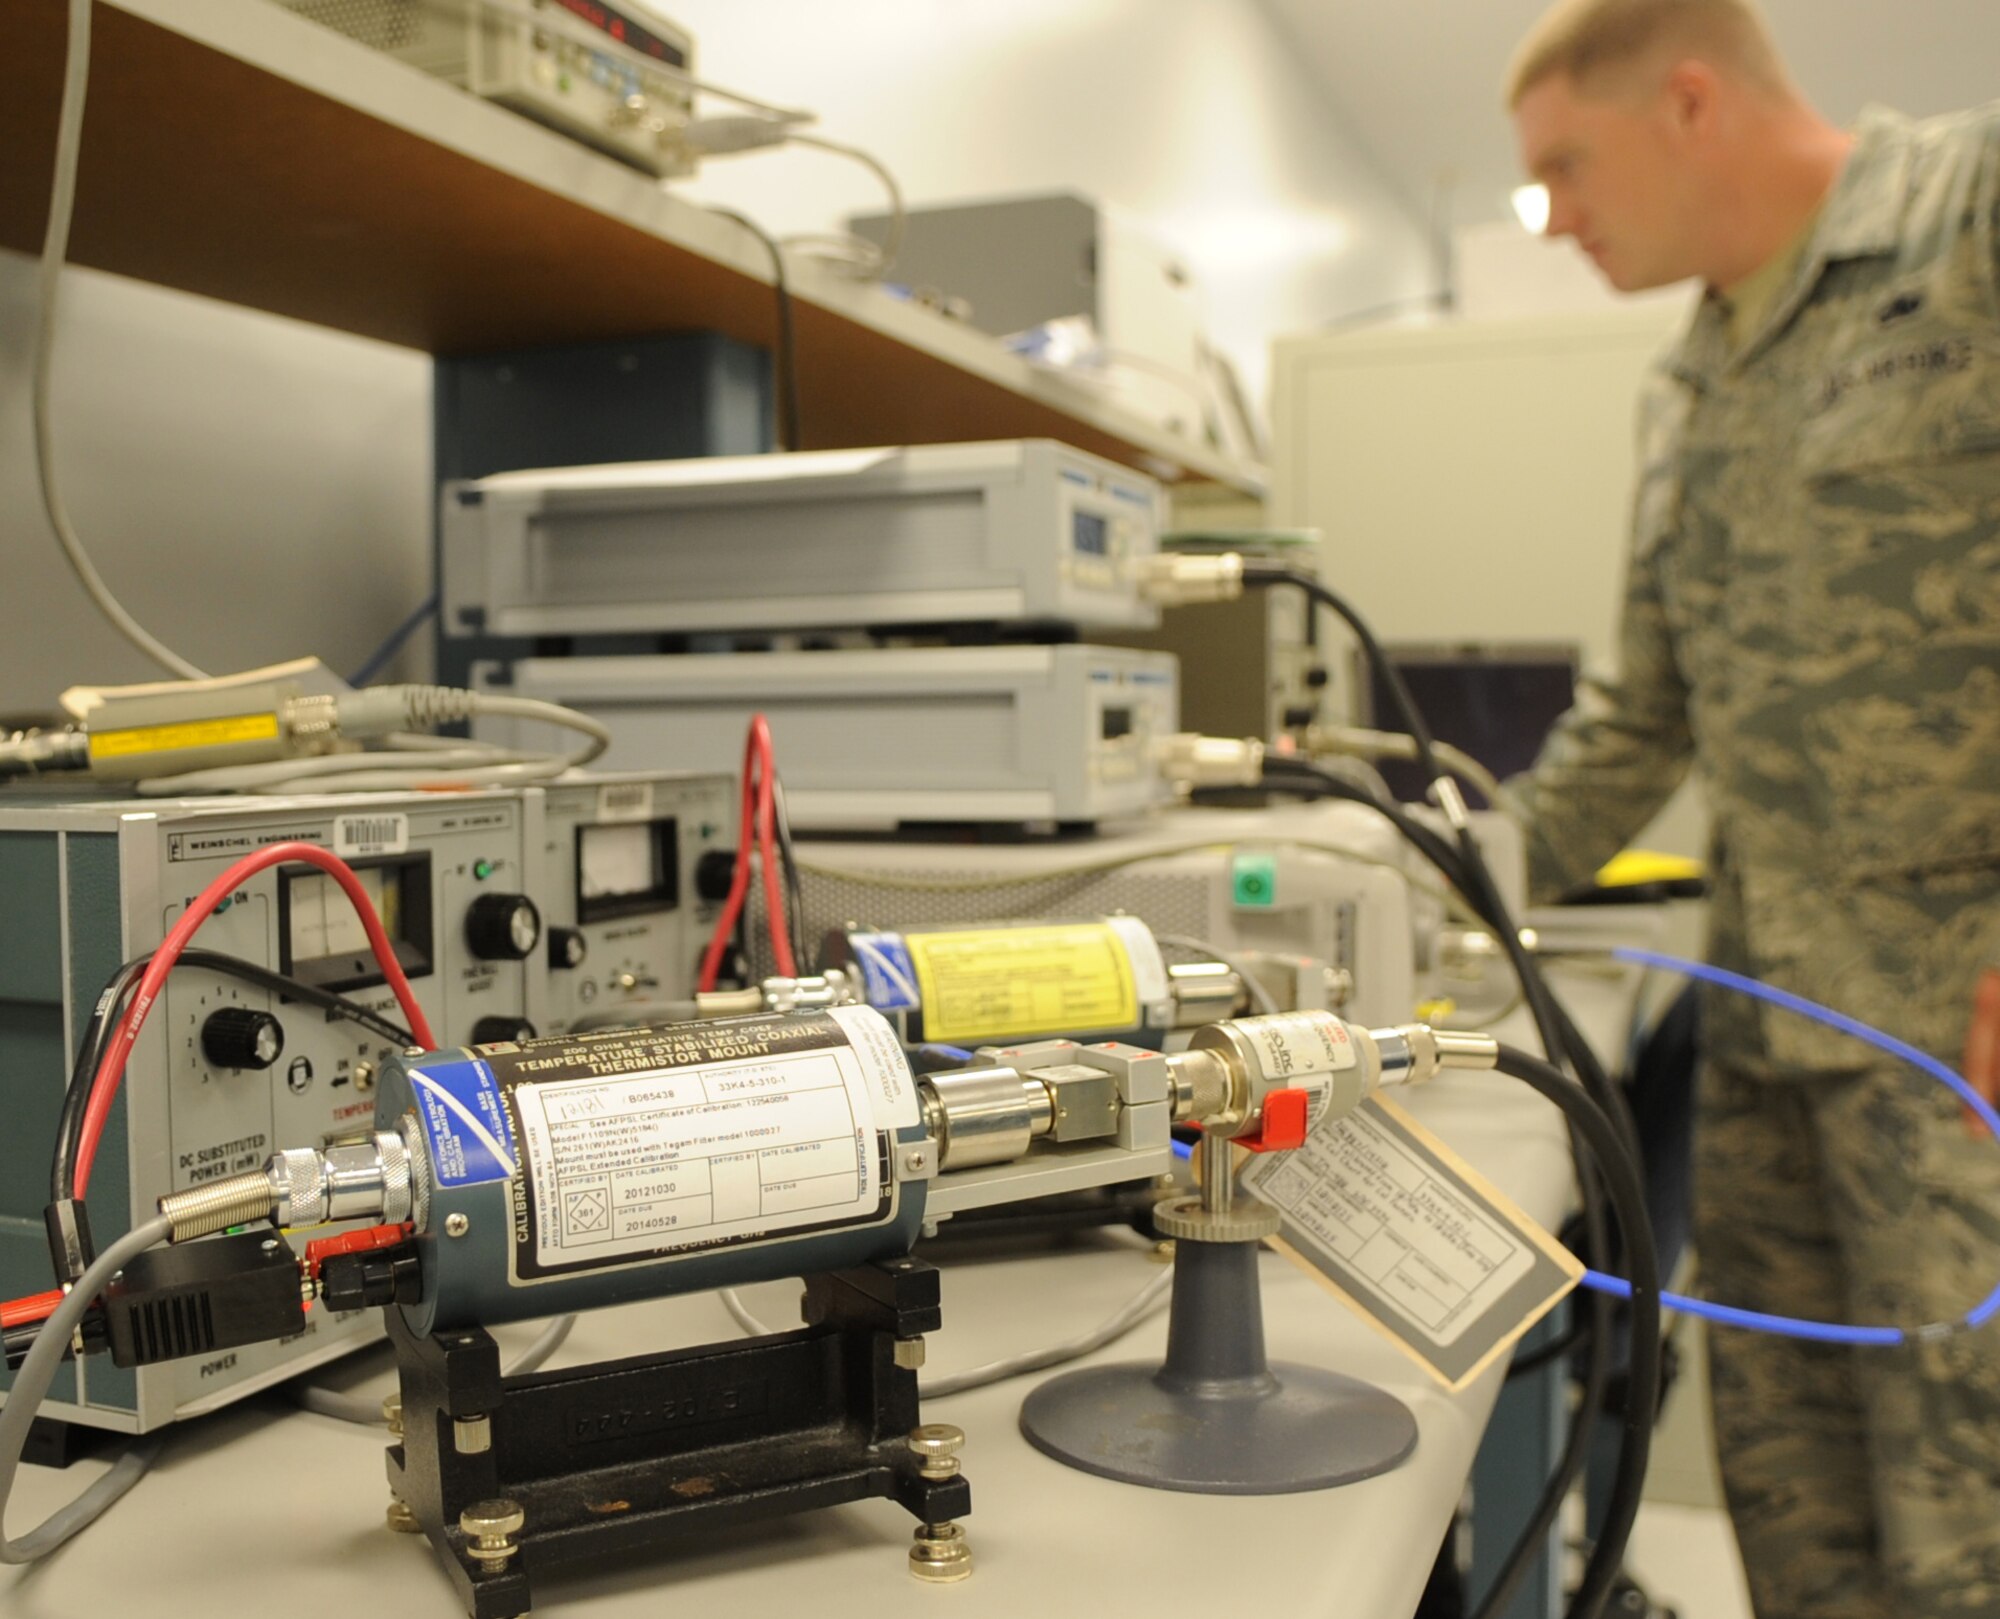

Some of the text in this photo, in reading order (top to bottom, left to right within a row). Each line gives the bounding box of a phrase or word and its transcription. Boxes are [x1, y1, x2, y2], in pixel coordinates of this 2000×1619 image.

[190, 831, 322, 850] WEINSCHEL ENGINEERING
[234, 891, 249, 904] ON
[216, 986, 223, 996] 5
[190, 1014, 196, 1025] 3
[187, 1037, 193, 1048] 2
[515, 1025, 828, 1072] TEMPERATURE STABILIZED COAXIAL
[562, 1024, 772, 1056] 200 OHM NEGATIVE TEMP COEF
[192, 1058, 197, 1069] 1
[588, 1042, 770, 1074] THERMISTOR MOUNT
[719, 1076, 787, 1092] 33K4-5-310-1
[543, 1088, 597, 1100] IDENTIFICATION
[333, 1100, 375, 1120] TEMPERA
[484, 1090, 506, 1147] MEASUREMENT
[589, 1120, 606, 1129] See
[608, 1116, 637, 1126] AFPSL
[640, 1111, 685, 1121] Certificate
[686, 1107, 695, 1115] of
[423, 1088, 451, 1179] AIR FORCE METROLOGY
[437, 1104, 459, 1178] AND CALIBRATION
[180, 1133, 266, 1168] DC SUBSTITUTED
[452, 1134, 467, 1178] PROGRAM
[554, 1144, 572, 1154] S/N
[556, 1154, 584, 1165] Mount
[586, 1151, 607, 1161] must
[608, 1149, 619, 1158] be
[621, 1146, 642, 1156] used
[644, 1143, 661, 1153] with
[663, 1140, 692, 1154] Tegam
[694, 1136, 716, 1146] Filter
[717, 1131, 743, 1142] model
[761, 1143, 822, 1158] DATE CALIBRATED
[857, 1127, 868, 1177] CERTIFICATION
[190, 1153, 261, 1183] POWER (mW)
[557, 1151, 680, 1175] AFPSL Extended Calibration
[710, 1153, 756, 1165] CERTIFIED BY
[615, 1164, 679, 1180] DATE CALIBRATED
[529, 1126, 548, 1249] PREVIOUS EDITION WILL BE USED
[558, 1176, 597, 1188] CERTIFIED
[624, 1182, 677, 1200] 20121030
[764, 1185, 782, 1193] DATE
[513, 1146, 529, 1243] CALIBRATION
[550, 1205, 559, 1227] FORM
[577, 1207, 595, 1218] 361
[618, 1205, 653, 1216] DATE DUE
[625, 1215, 678, 1232] 20140528
[551, 1229, 559, 1247] AFTO
[200, 1352, 238, 1378] POWER
